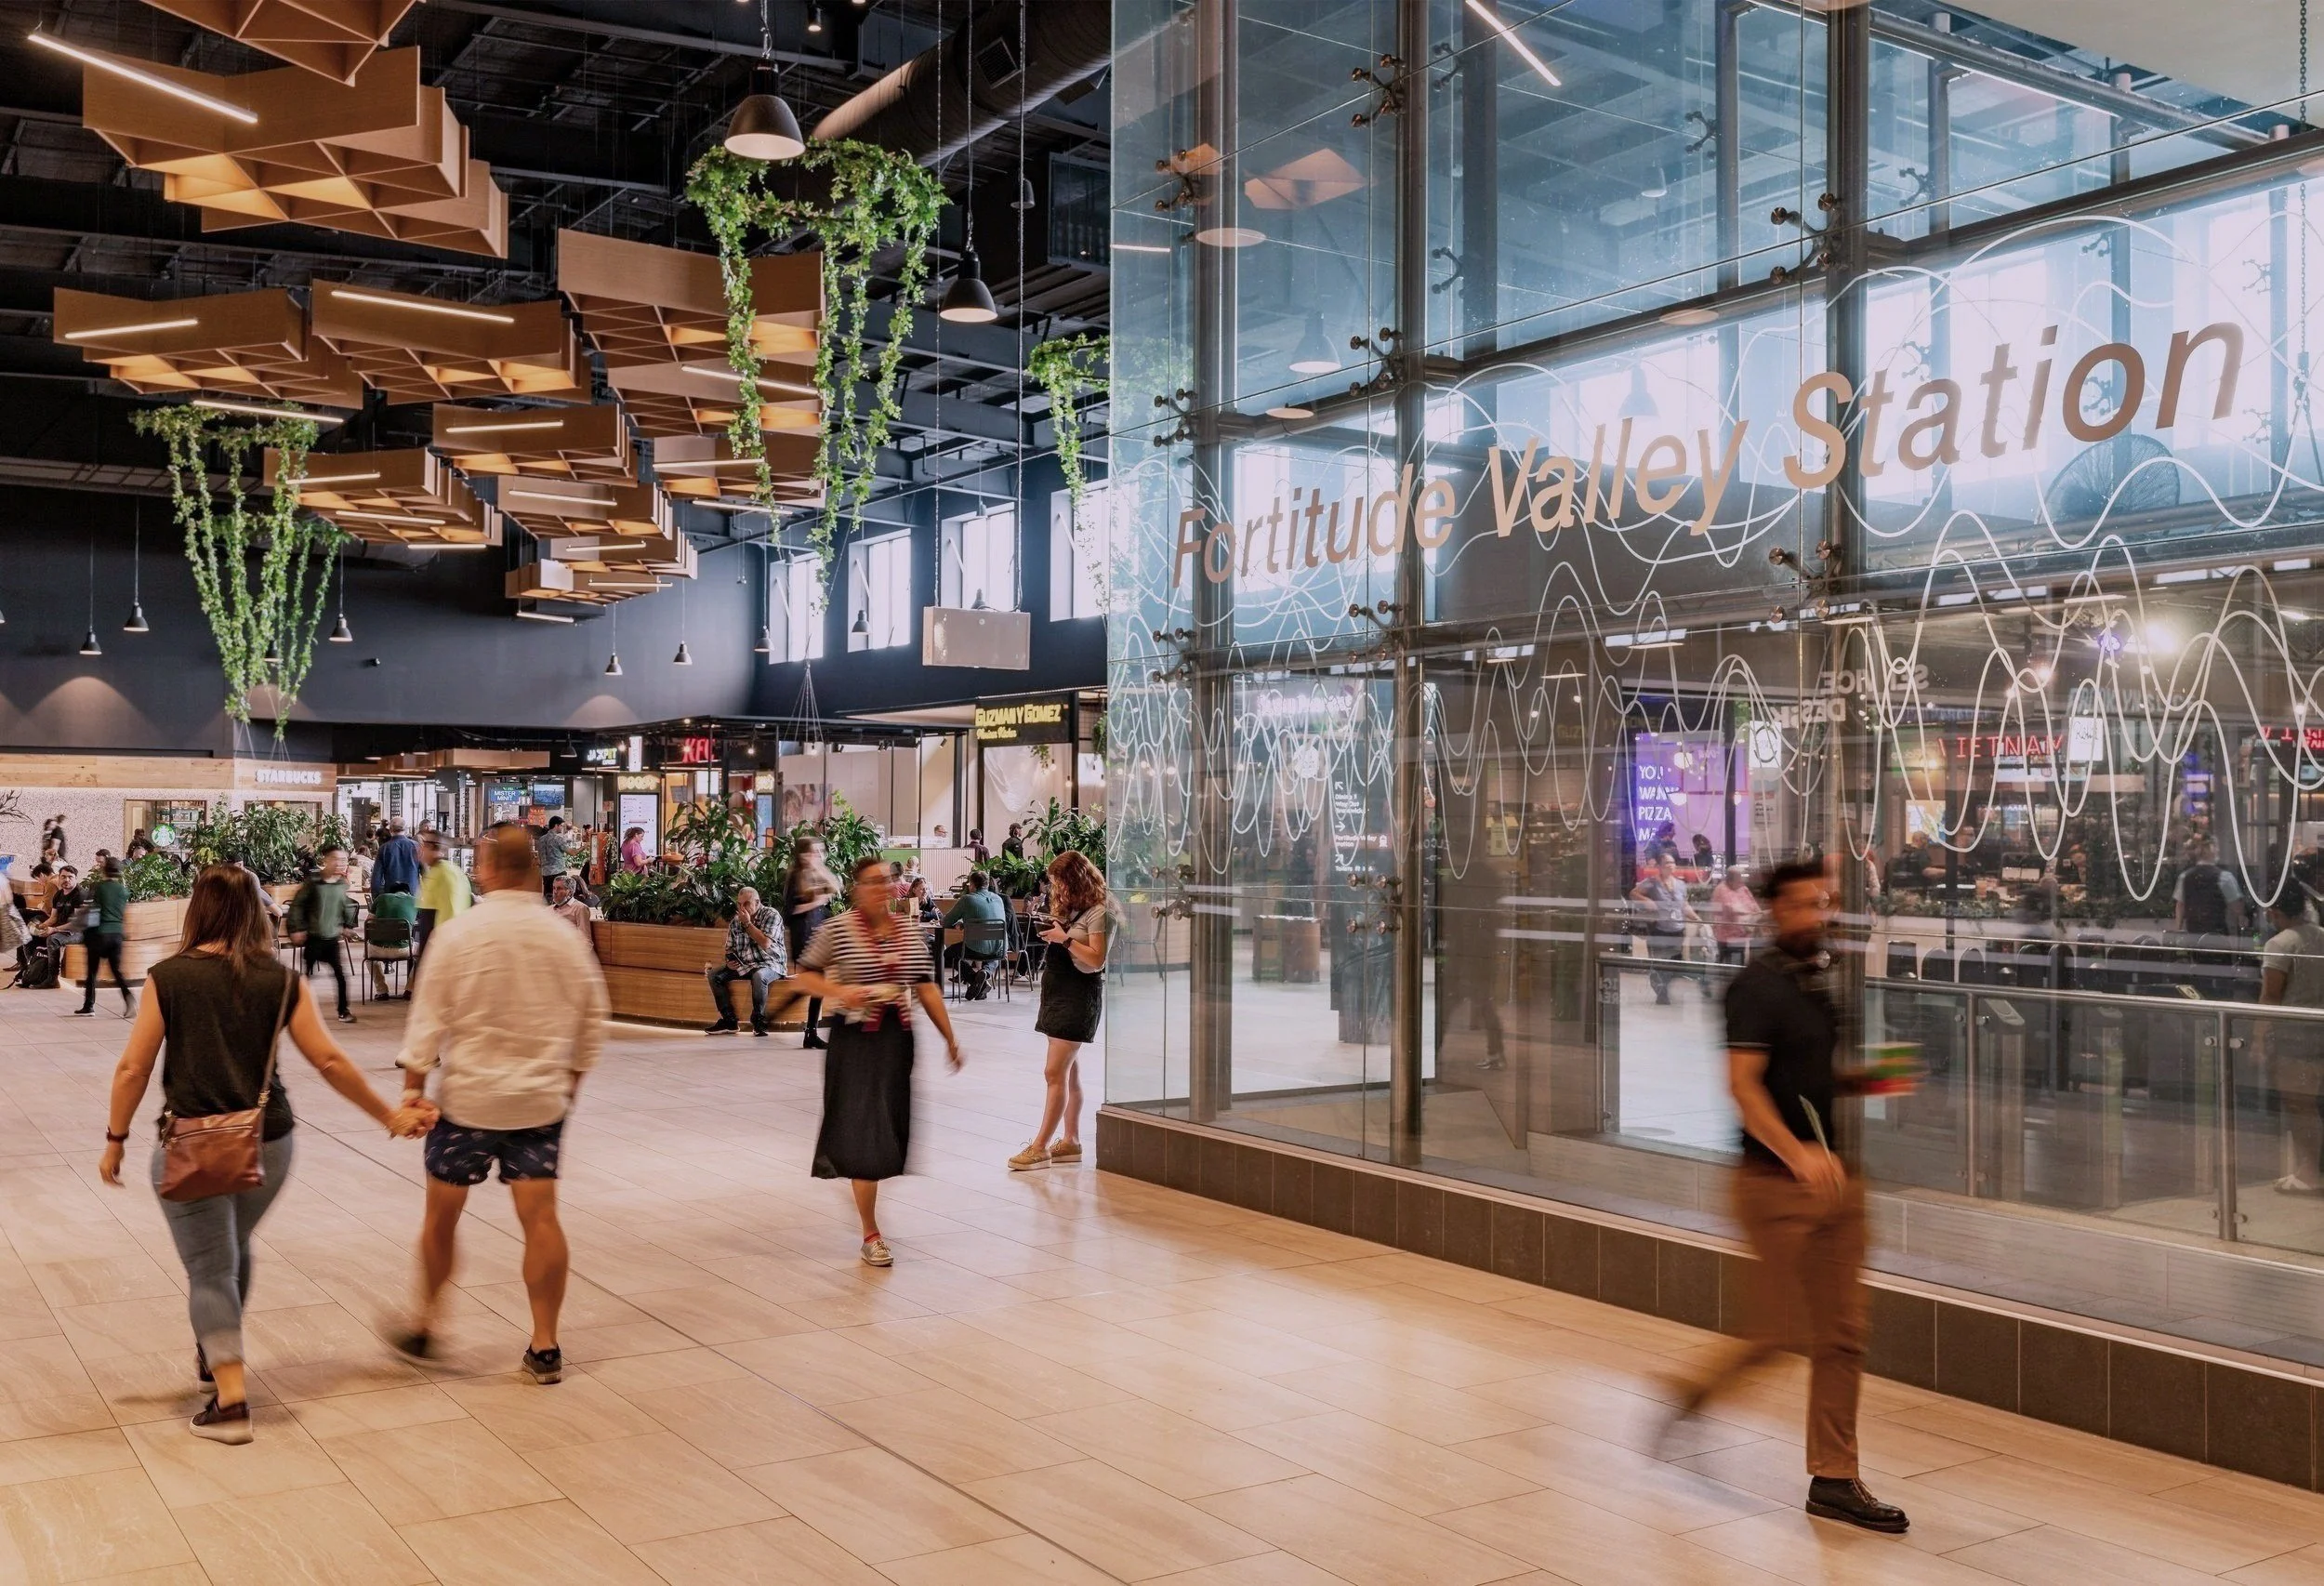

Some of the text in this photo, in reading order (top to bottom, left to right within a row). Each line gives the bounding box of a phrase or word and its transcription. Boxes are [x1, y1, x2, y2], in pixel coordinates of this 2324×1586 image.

[1172, 322, 2245, 588] Fortitude Valley Station
[975, 704, 1062, 727] GUZMAN Y GOMEZ
[682, 738, 716, 763] KFC
[256, 769, 322, 785] STARBUCKS
[1639, 806, 1673, 821] PIZZA
